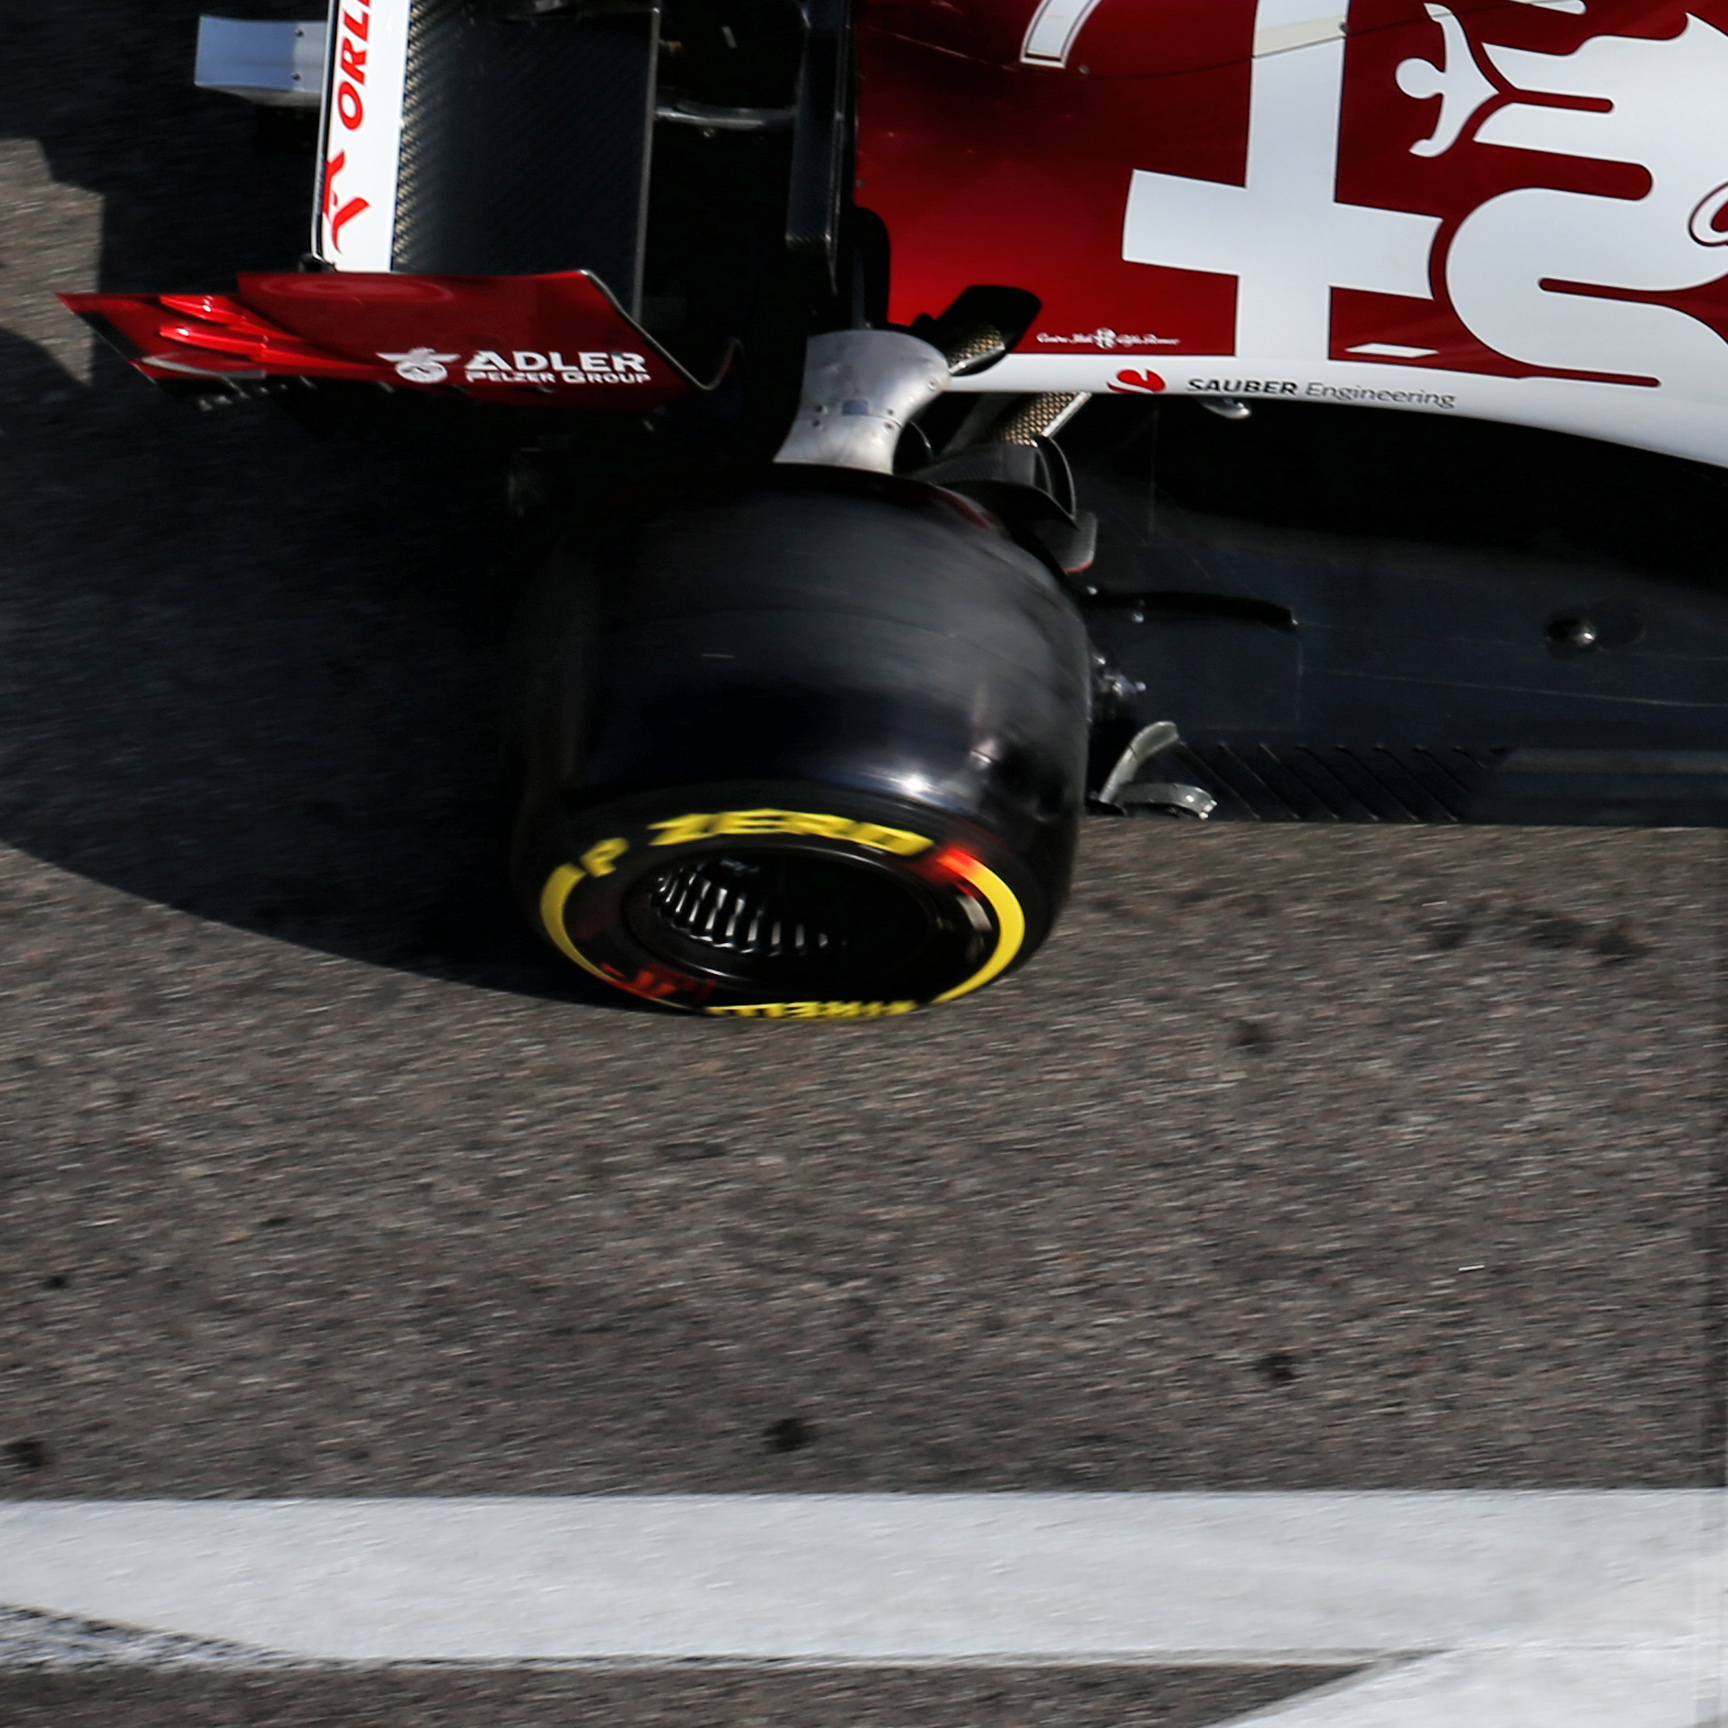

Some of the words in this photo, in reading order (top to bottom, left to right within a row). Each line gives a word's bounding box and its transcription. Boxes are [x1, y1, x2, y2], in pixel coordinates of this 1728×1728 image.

[464, 350, 647, 373] ADLER
[465, 370, 555, 384] PELZER
[562, 371, 652, 384] GROUP
[1187, 378, 1298, 395] SAUBER
[1305, 382, 1457, 409] Engineering
[581, 836, 630, 878] P
[648, 808, 936, 858] ZERO
